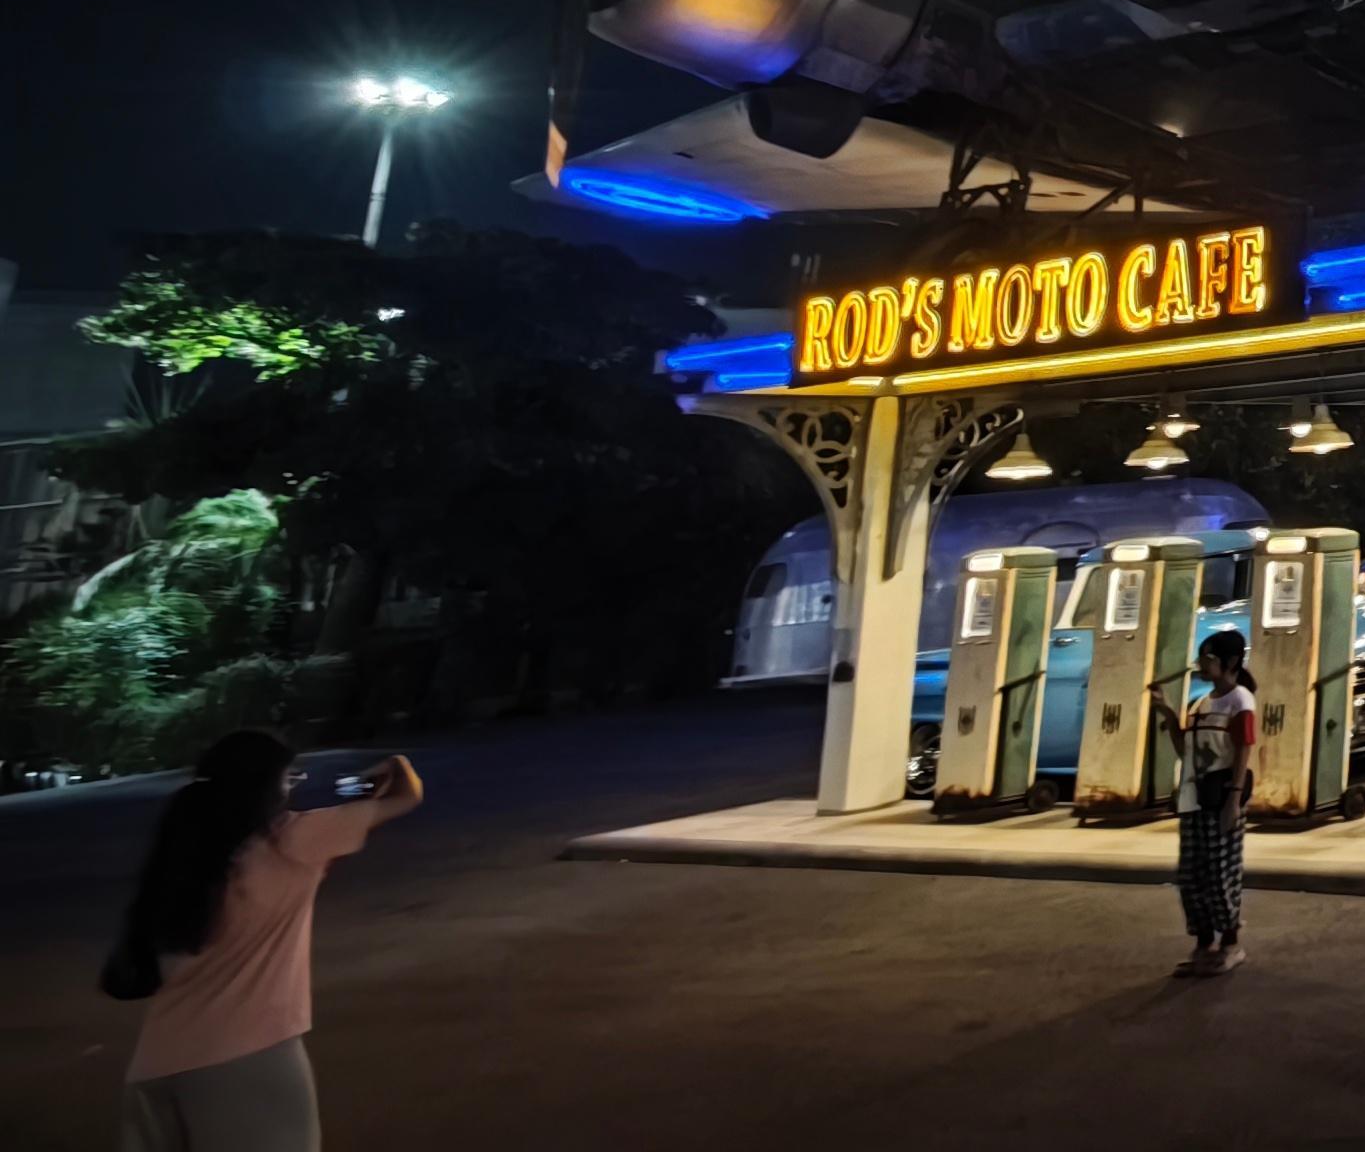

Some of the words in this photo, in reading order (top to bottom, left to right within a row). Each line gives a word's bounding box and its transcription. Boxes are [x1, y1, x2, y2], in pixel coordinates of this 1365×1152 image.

[799, 278, 944, 372] ROD'S
[947, 251, 1110, 352] MOTO
[1118, 225, 1266, 333] CAFE
